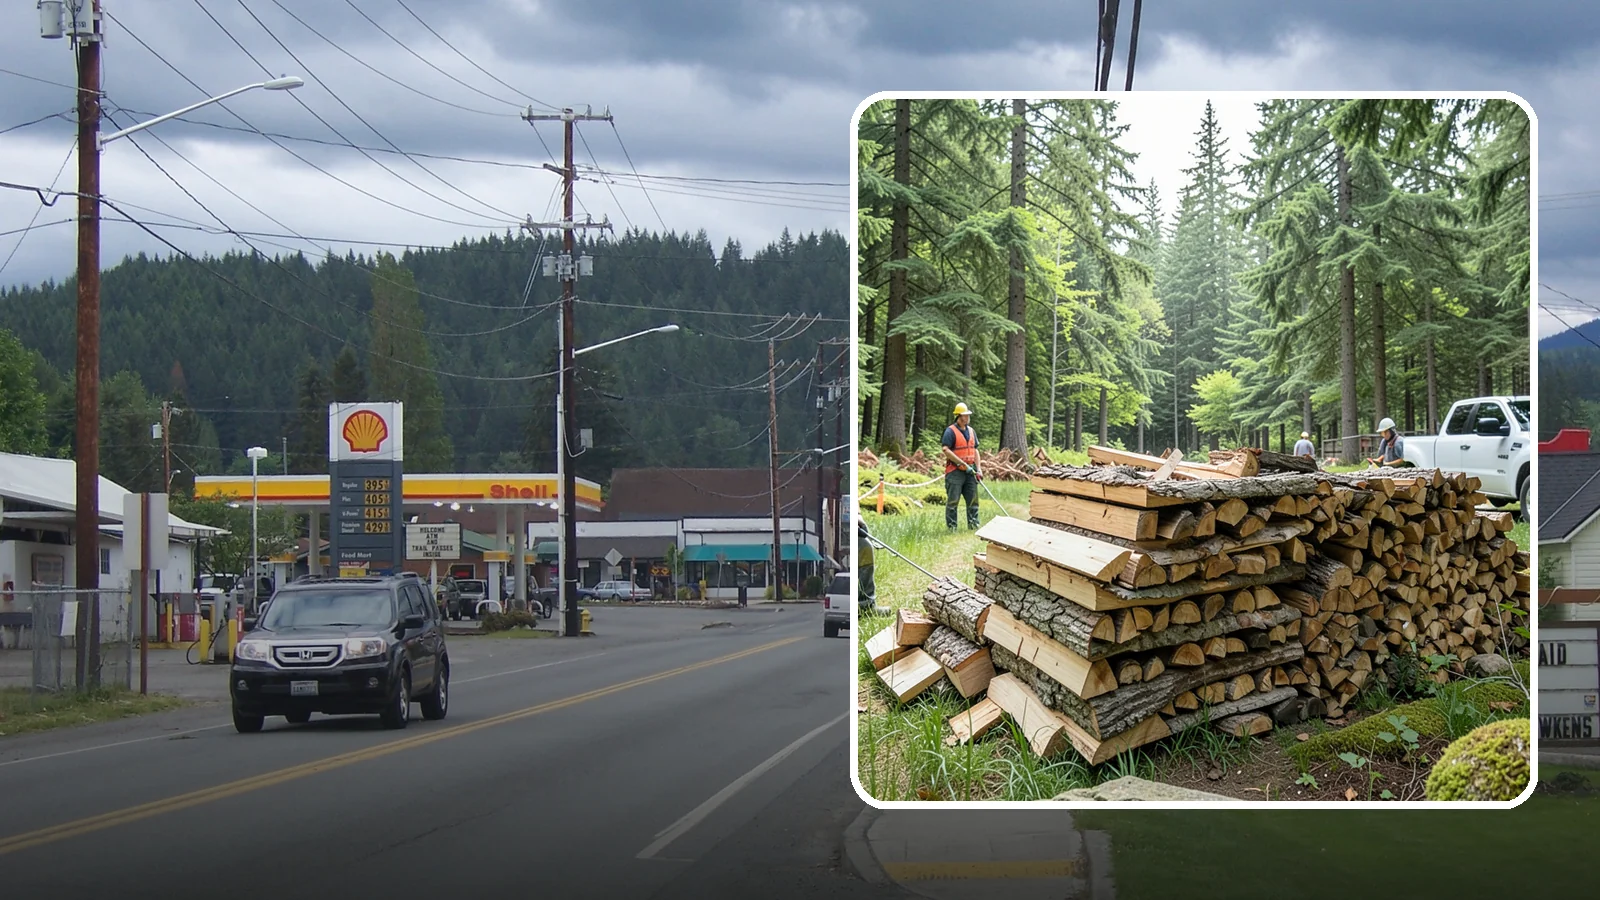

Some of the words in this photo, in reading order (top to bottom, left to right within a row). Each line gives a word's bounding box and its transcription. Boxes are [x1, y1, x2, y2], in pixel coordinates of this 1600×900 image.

[366, 480, 384, 490] 395
[490, 484, 547, 499] Shell
[366, 494, 384, 504] 405
[366, 508, 383, 518] 415
[366, 522, 383, 532] 429
